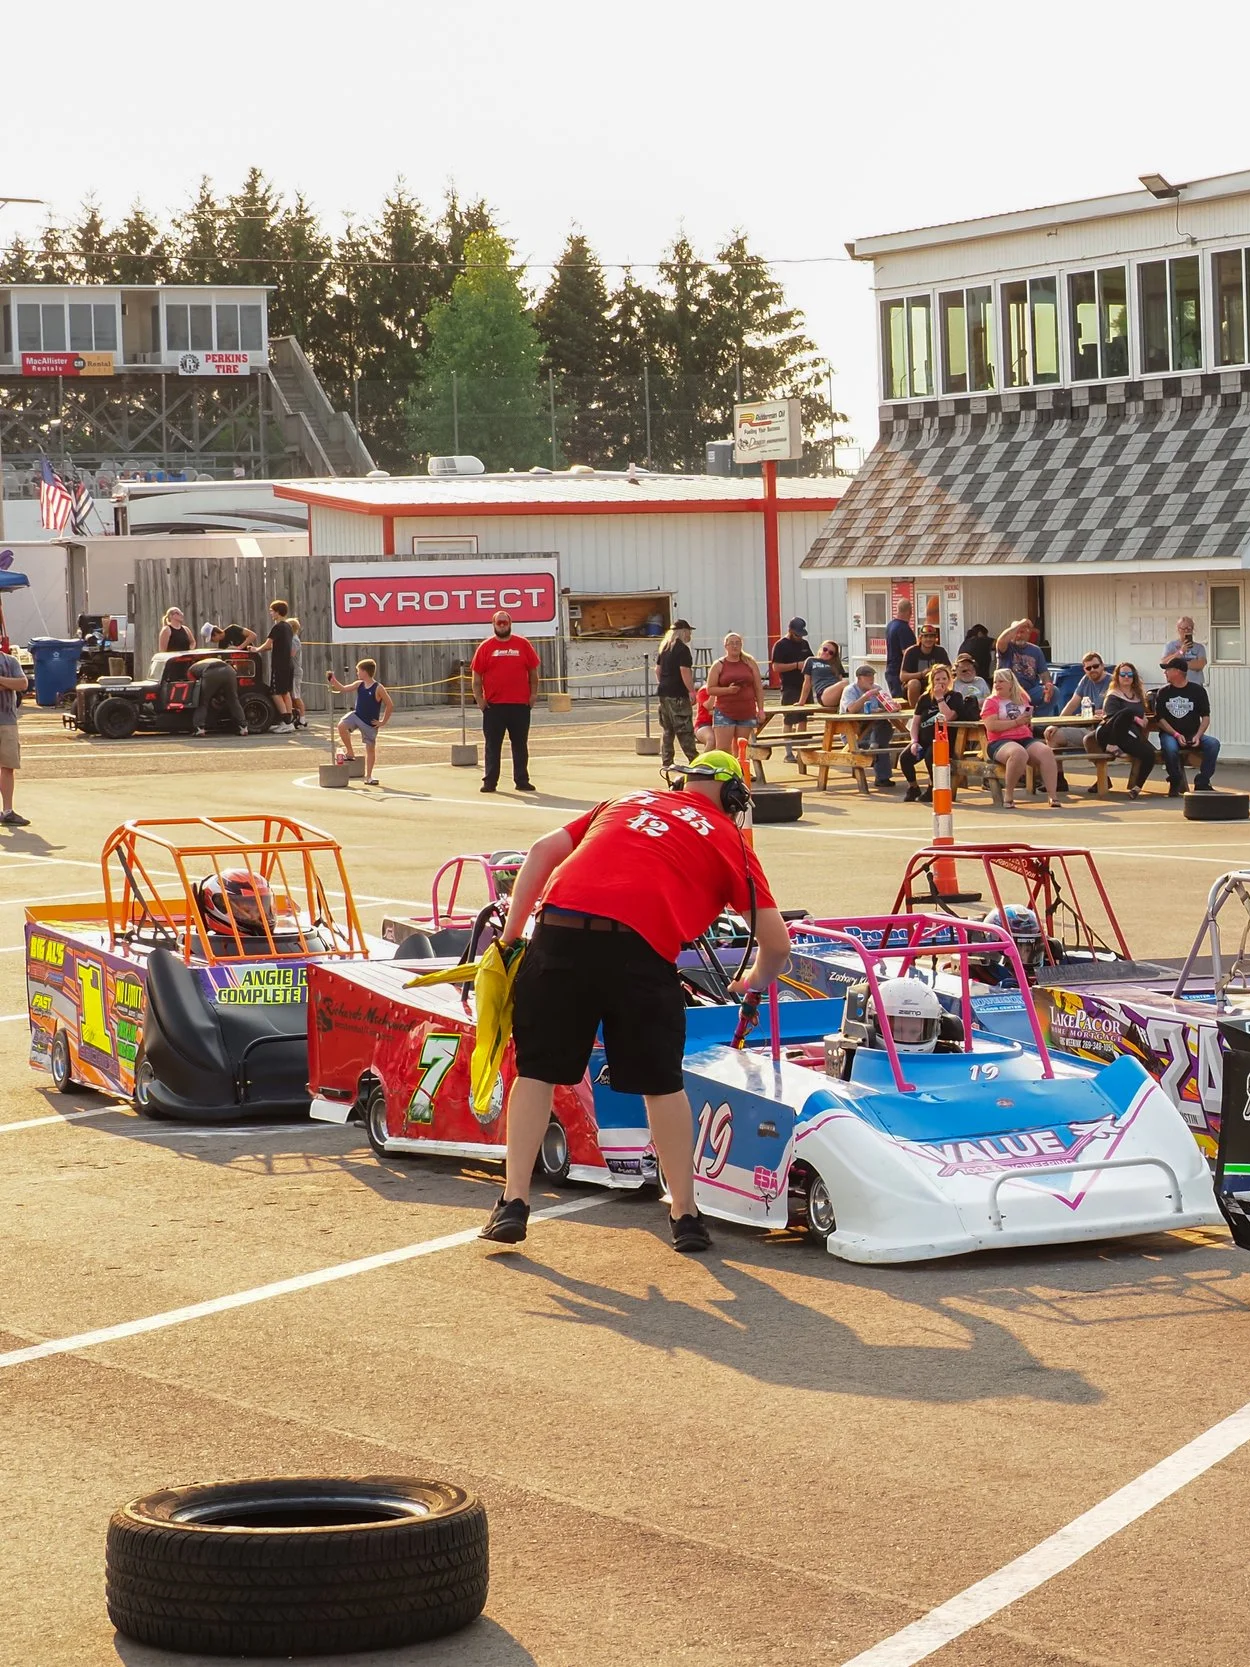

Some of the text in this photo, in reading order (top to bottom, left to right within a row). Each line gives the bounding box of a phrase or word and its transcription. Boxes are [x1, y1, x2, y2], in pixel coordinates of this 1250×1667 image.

[26, 357, 68, 365] MacAllister
[205, 354, 248, 363] PERKINS
[215, 364, 239, 374] TIRE
[344, 588, 546, 612] PYROTECT
[626, 808, 670, 837] 42
[242, 968, 292, 986] ANGIE
[218, 988, 301, 1004] COMPLETE
[76, 959, 114, 1056] 1
[1070, 1028, 1122, 1043] MORTGAGE
[408, 1033, 462, 1125] 7
[970, 1062, 998, 1080] 19
[694, 1100, 732, 1178] 19
[921, 1130, 1066, 1164] VALUE
